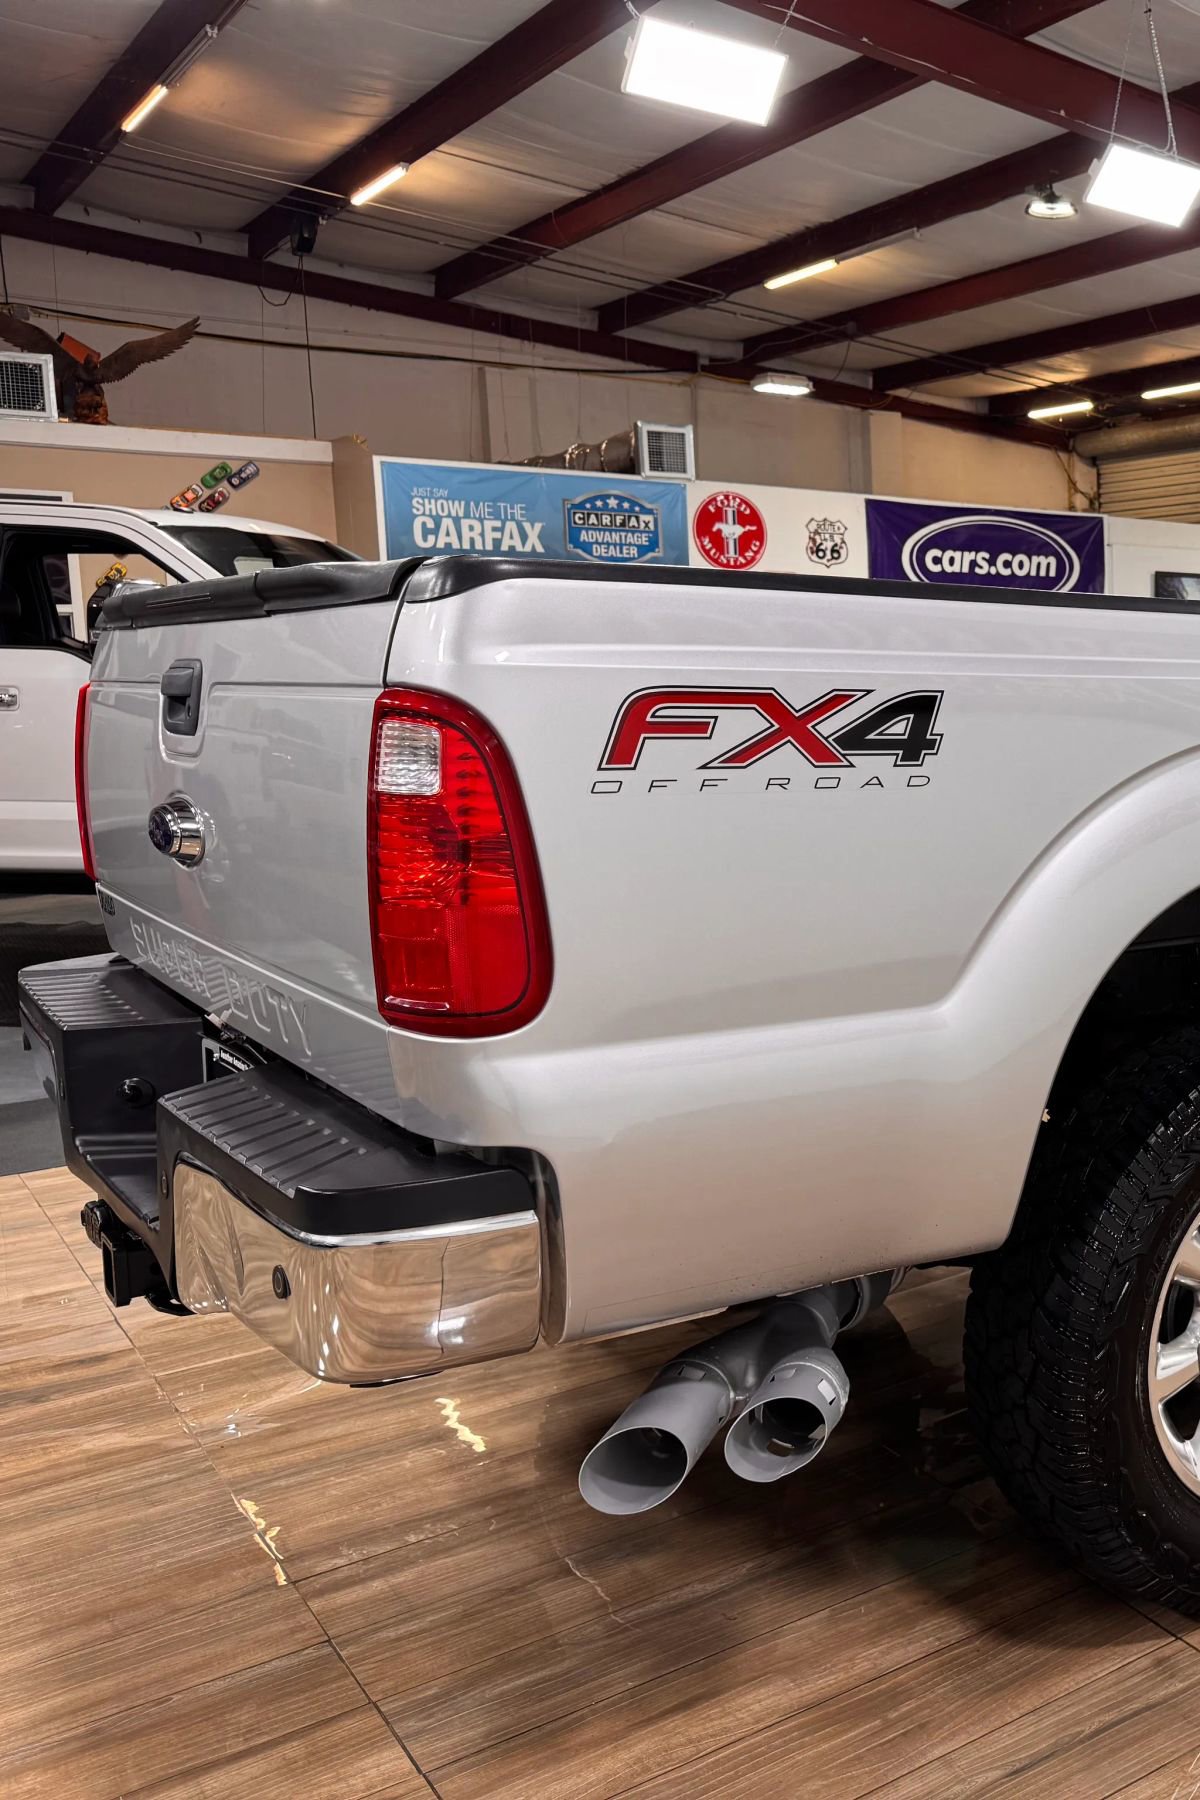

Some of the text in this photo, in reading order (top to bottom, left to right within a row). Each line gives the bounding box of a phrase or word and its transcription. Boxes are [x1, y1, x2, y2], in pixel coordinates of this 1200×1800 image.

[411, 487, 448, 498] JUST SAY
[411, 497, 527, 521] SHOW ME THE
[708, 495, 750, 515] FORD
[573, 511, 655, 531] CARFAX
[816, 522, 836, 533] ROUTE
[413, 516, 545, 553] CARFAX
[580, 530, 650, 546] ADVANTAGE
[592, 543, 639, 558] DEALER
[701, 536, 760, 565] MUSTANG
[815, 542, 842, 560] 66
[924, 548, 1057, 577] cars.com
[597, 685, 945, 771] FX4
[591, 775, 931, 794] OFF ROAD
[221, 965, 312, 1057] DUTY
